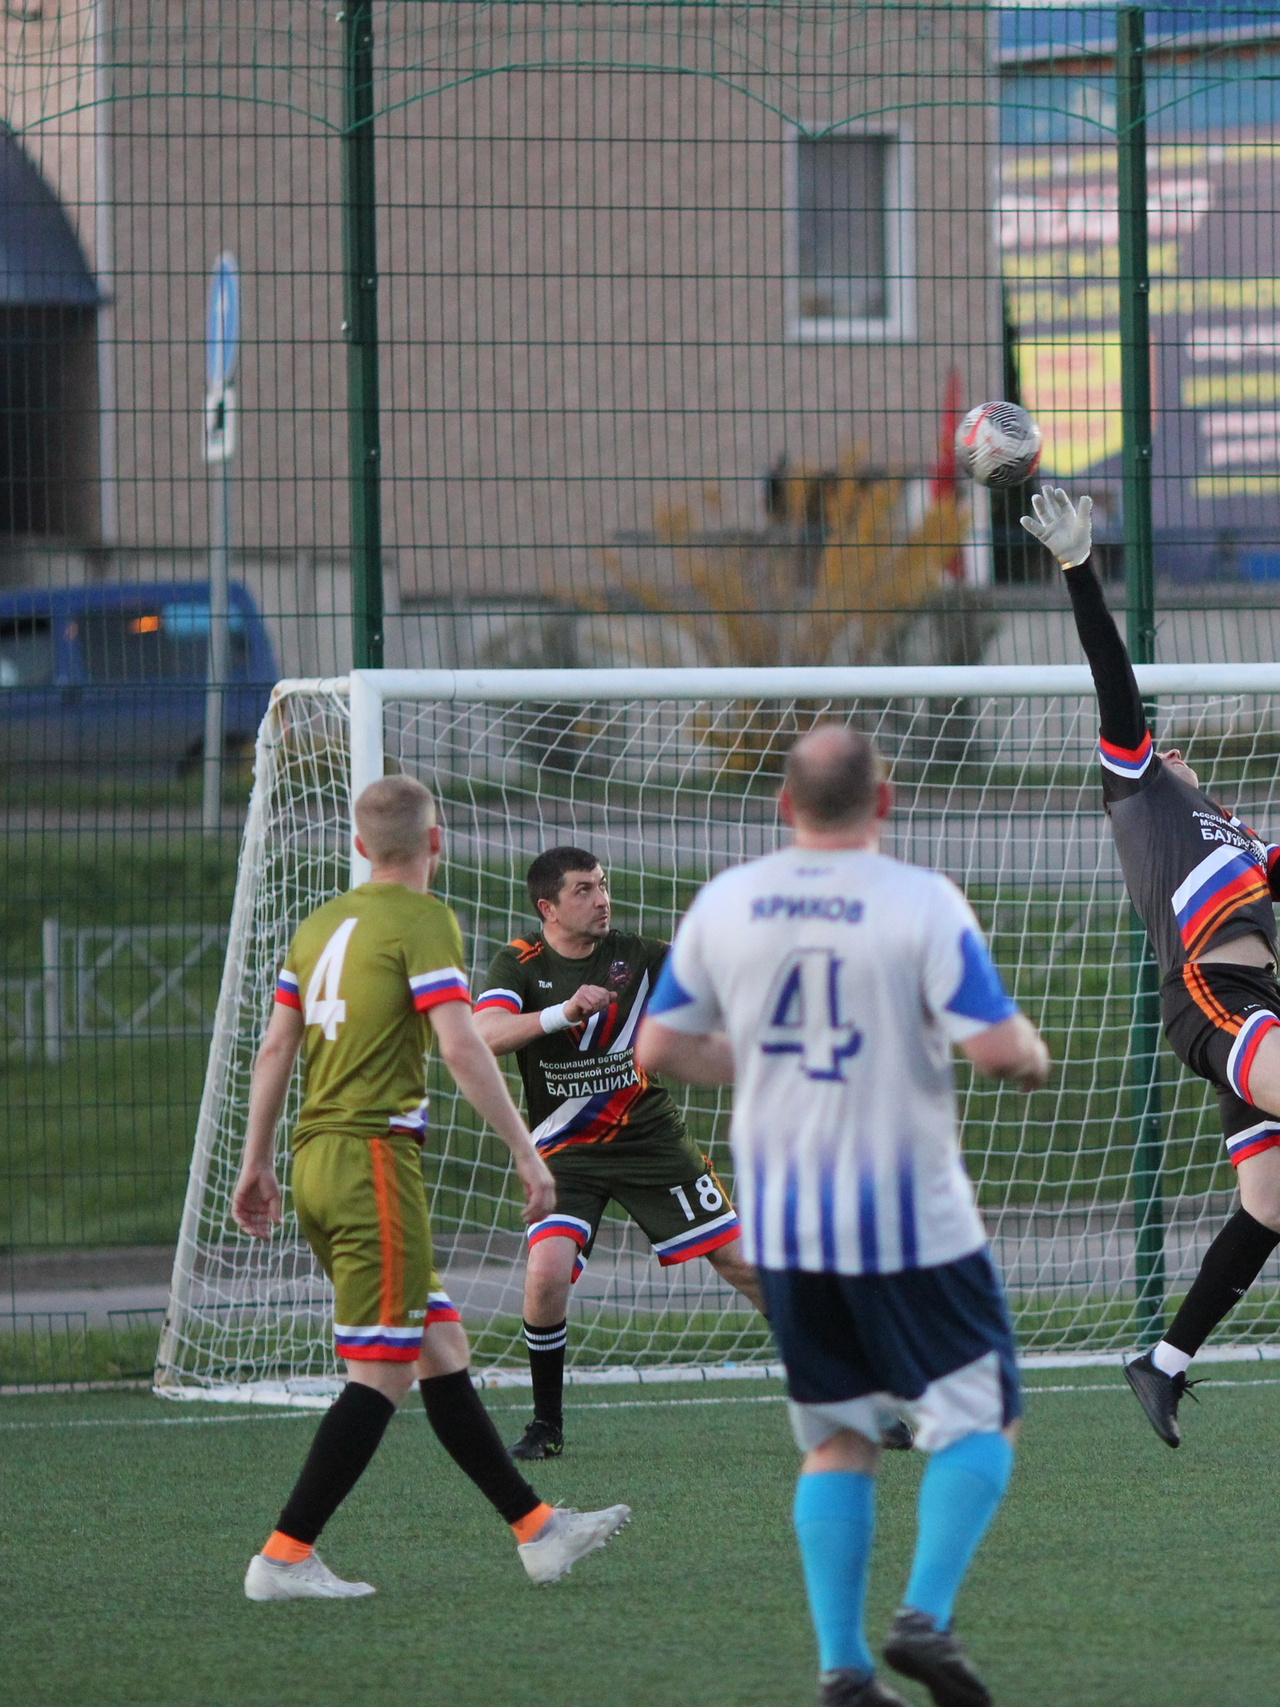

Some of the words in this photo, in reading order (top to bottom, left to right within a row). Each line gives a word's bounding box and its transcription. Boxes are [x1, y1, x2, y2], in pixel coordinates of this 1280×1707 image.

[304, 918, 358, 1041] 4
[760, 947, 863, 1083] 4
[539, 1058, 596, 1071] Ассоциация
[544, 1067, 602, 1081] Московской
[546, 1069, 640, 1098] БАЛАШИХА
[669, 1173, 723, 1221] 18
